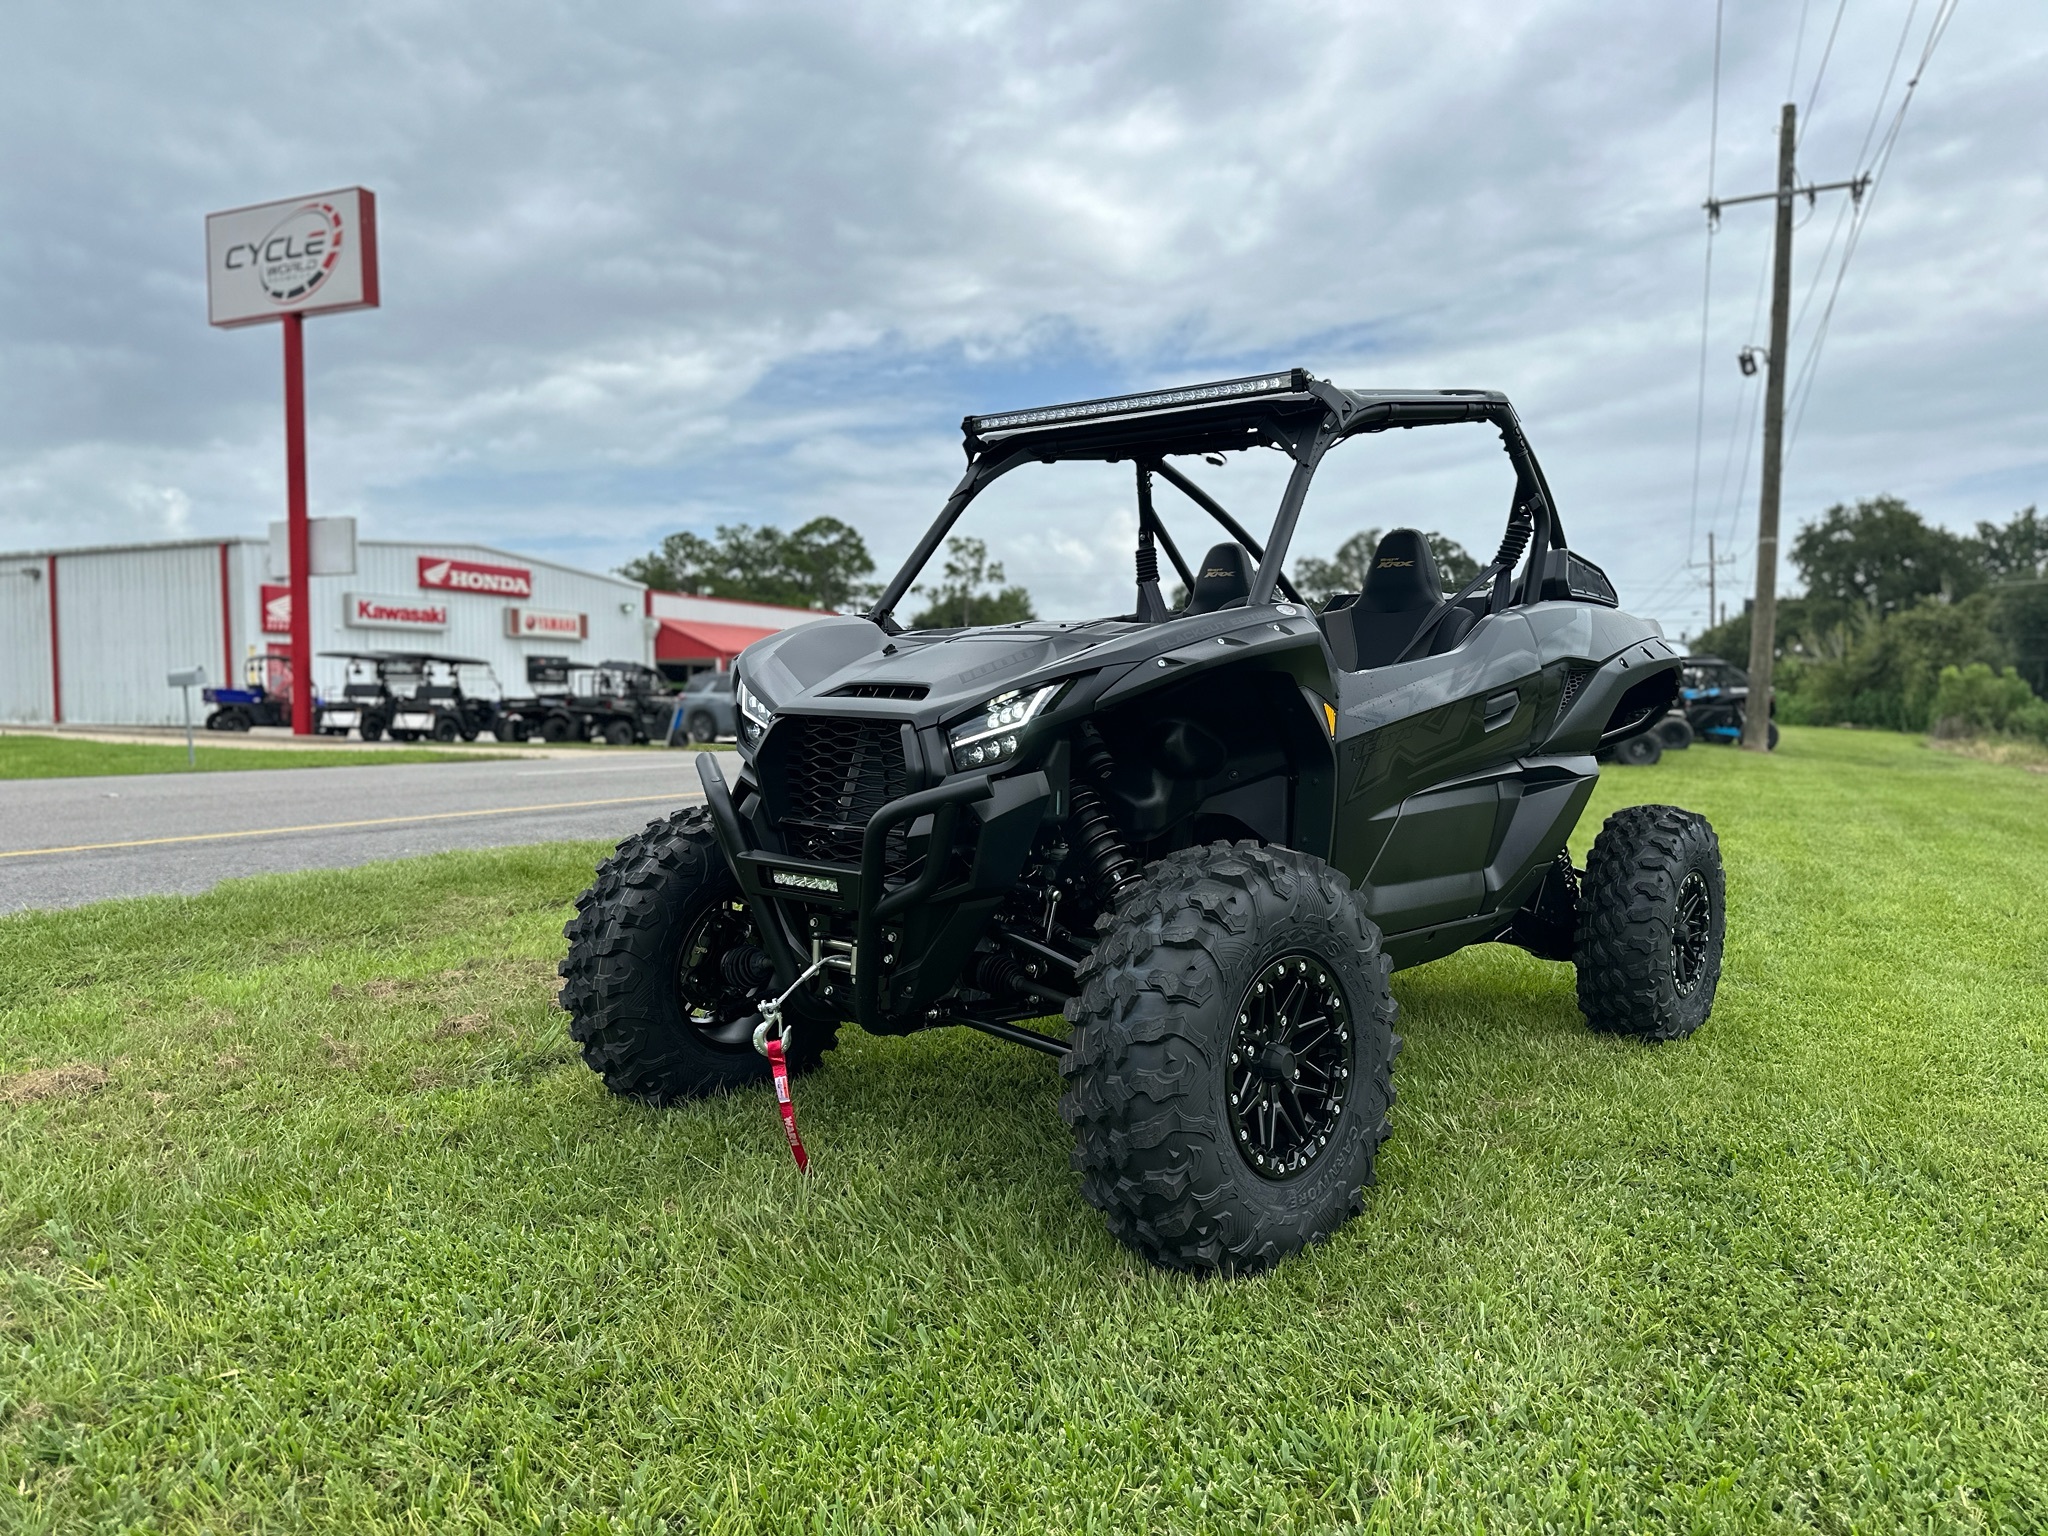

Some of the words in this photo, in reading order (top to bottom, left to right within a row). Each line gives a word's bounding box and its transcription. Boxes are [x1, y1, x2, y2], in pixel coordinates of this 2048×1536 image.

[226, 231, 326, 269] CYCLE
[449, 570, 531, 594] HONDA
[357, 600, 447, 624] Kawasaki
[1154, 620, 1226, 651] BLACKOUT
[1231, 610, 1276, 626] EDITION
[784, 1116, 799, 1146] WARN
[1285, 1125, 1359, 1209] CARNIVORE
